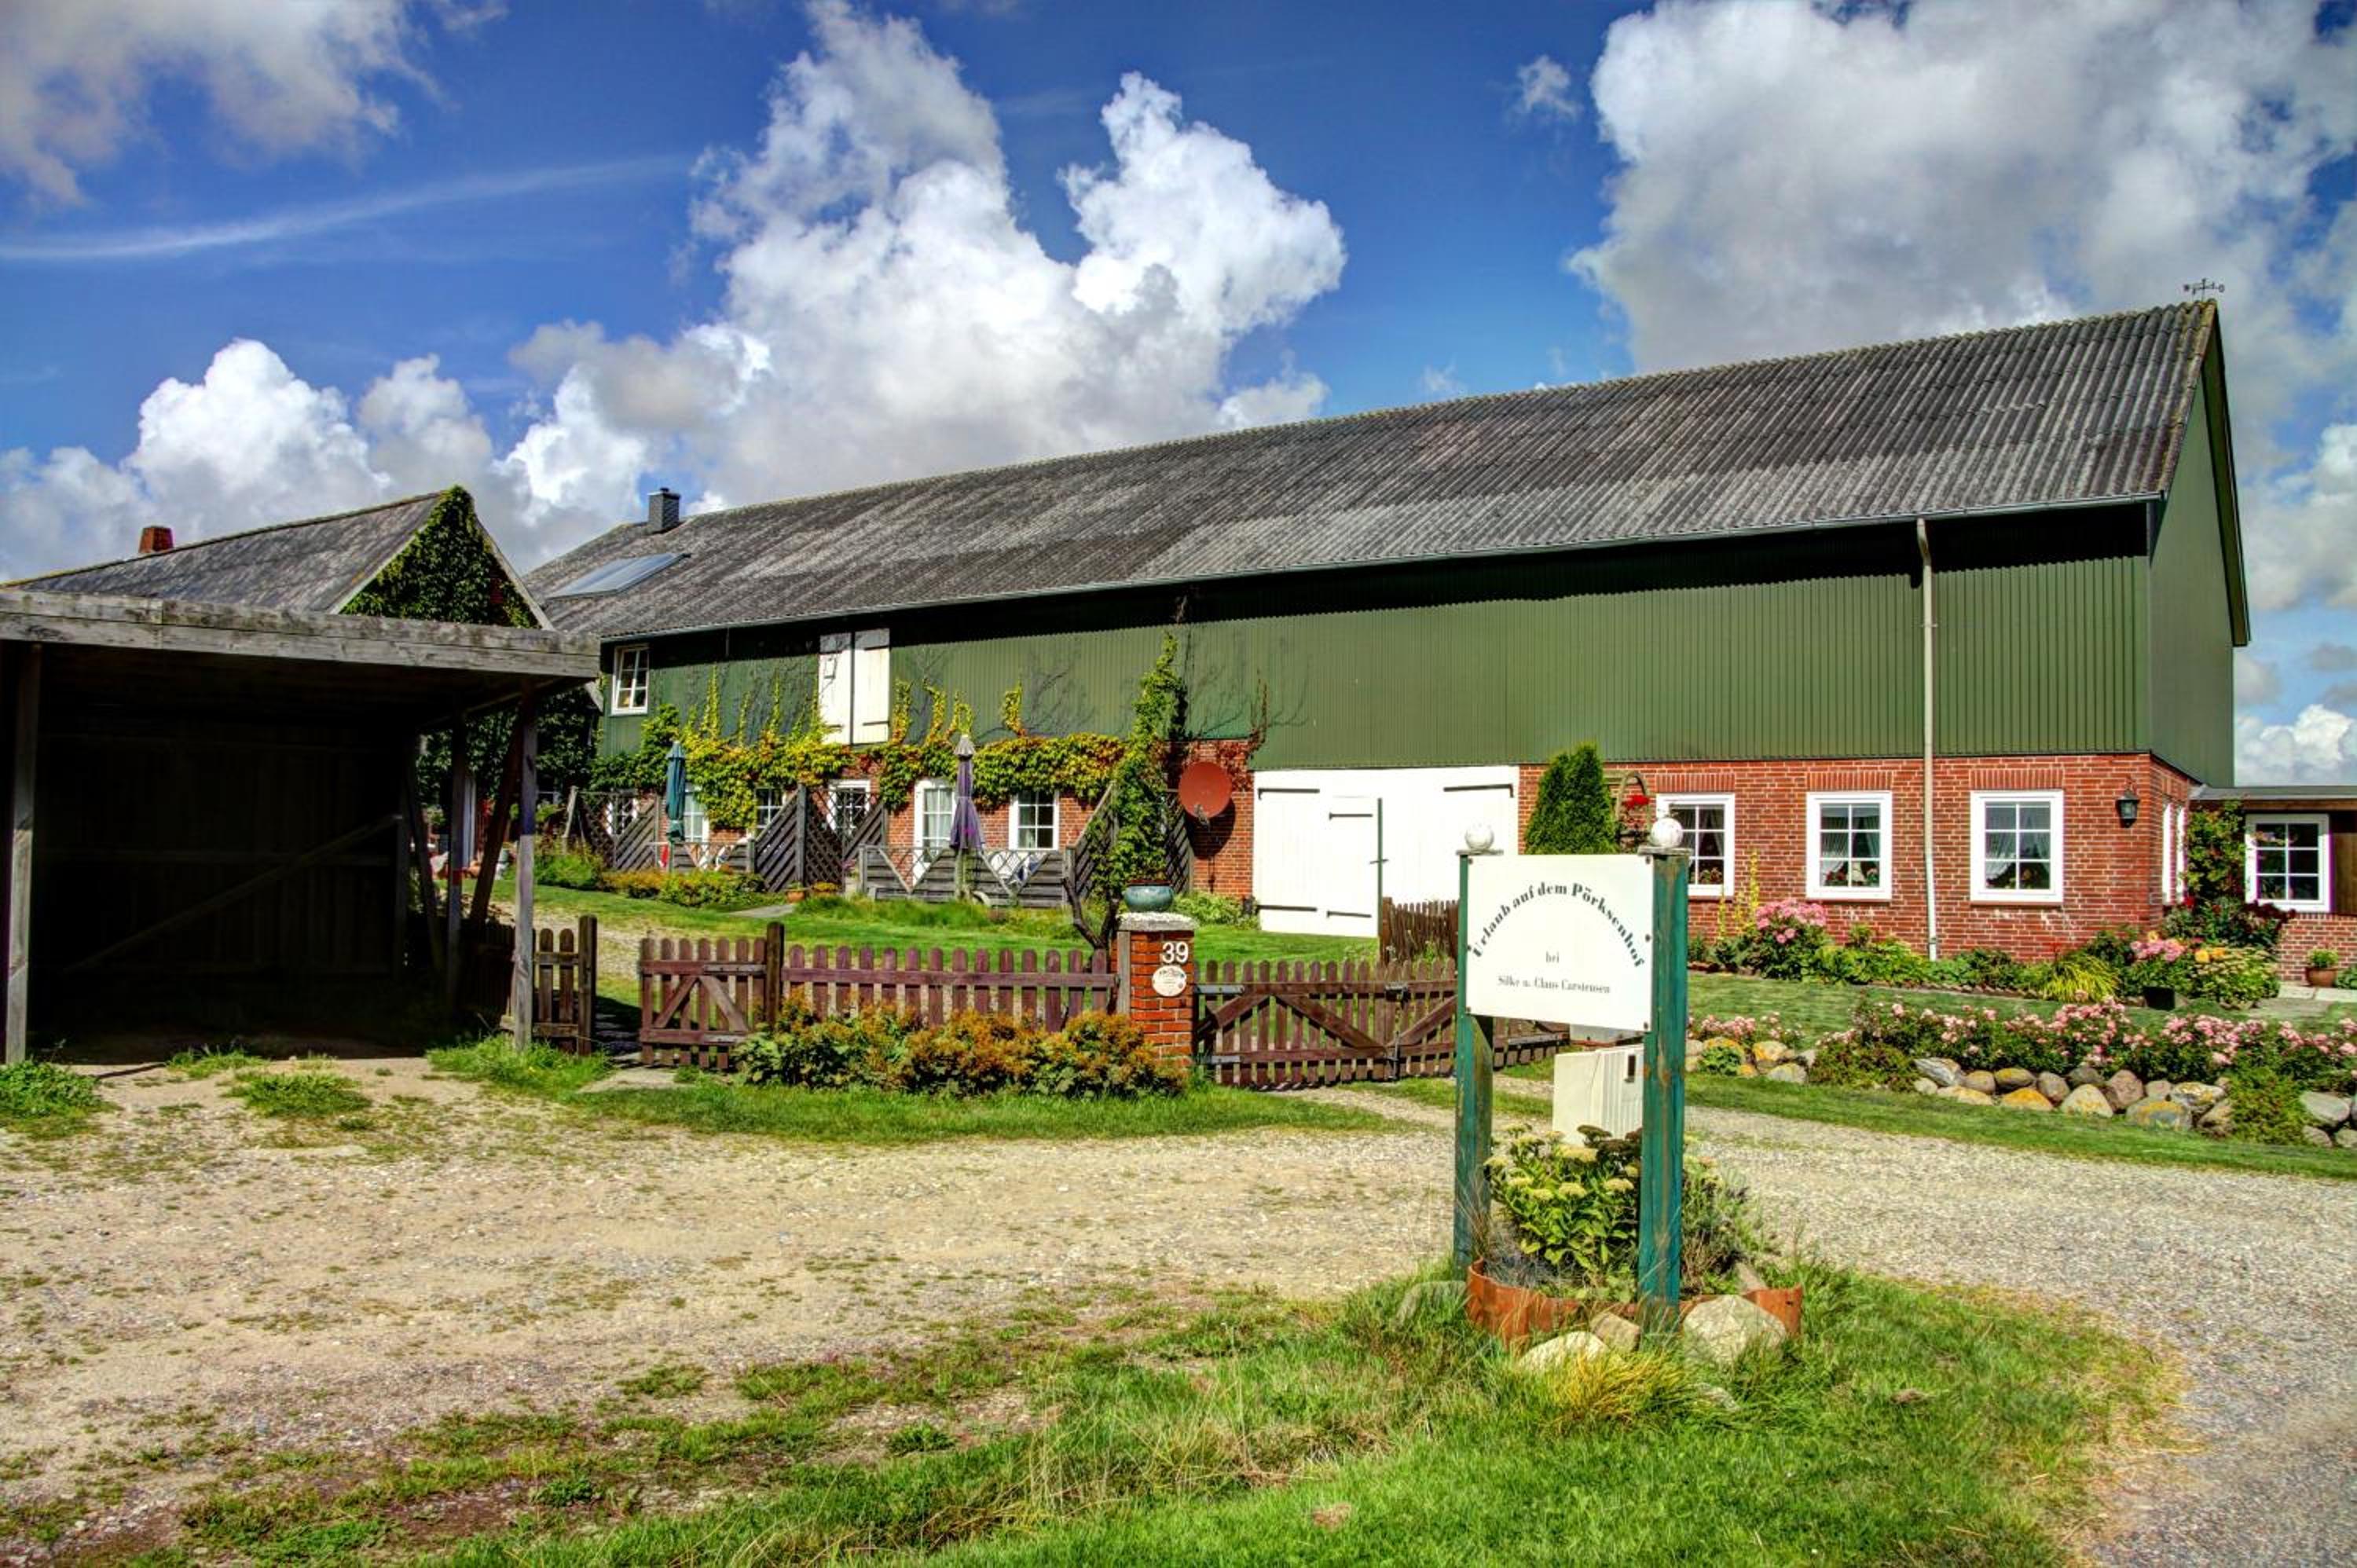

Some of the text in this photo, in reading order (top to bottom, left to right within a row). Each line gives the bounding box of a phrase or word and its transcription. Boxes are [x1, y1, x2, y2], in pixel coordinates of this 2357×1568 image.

[1472, 881, 1645, 967] Urlaub auf dem Pörksenhof
[1162, 941, 1189, 964] 39
[1545, 951, 1560, 963] bei
[1534, 976, 1559, 989] Claus
